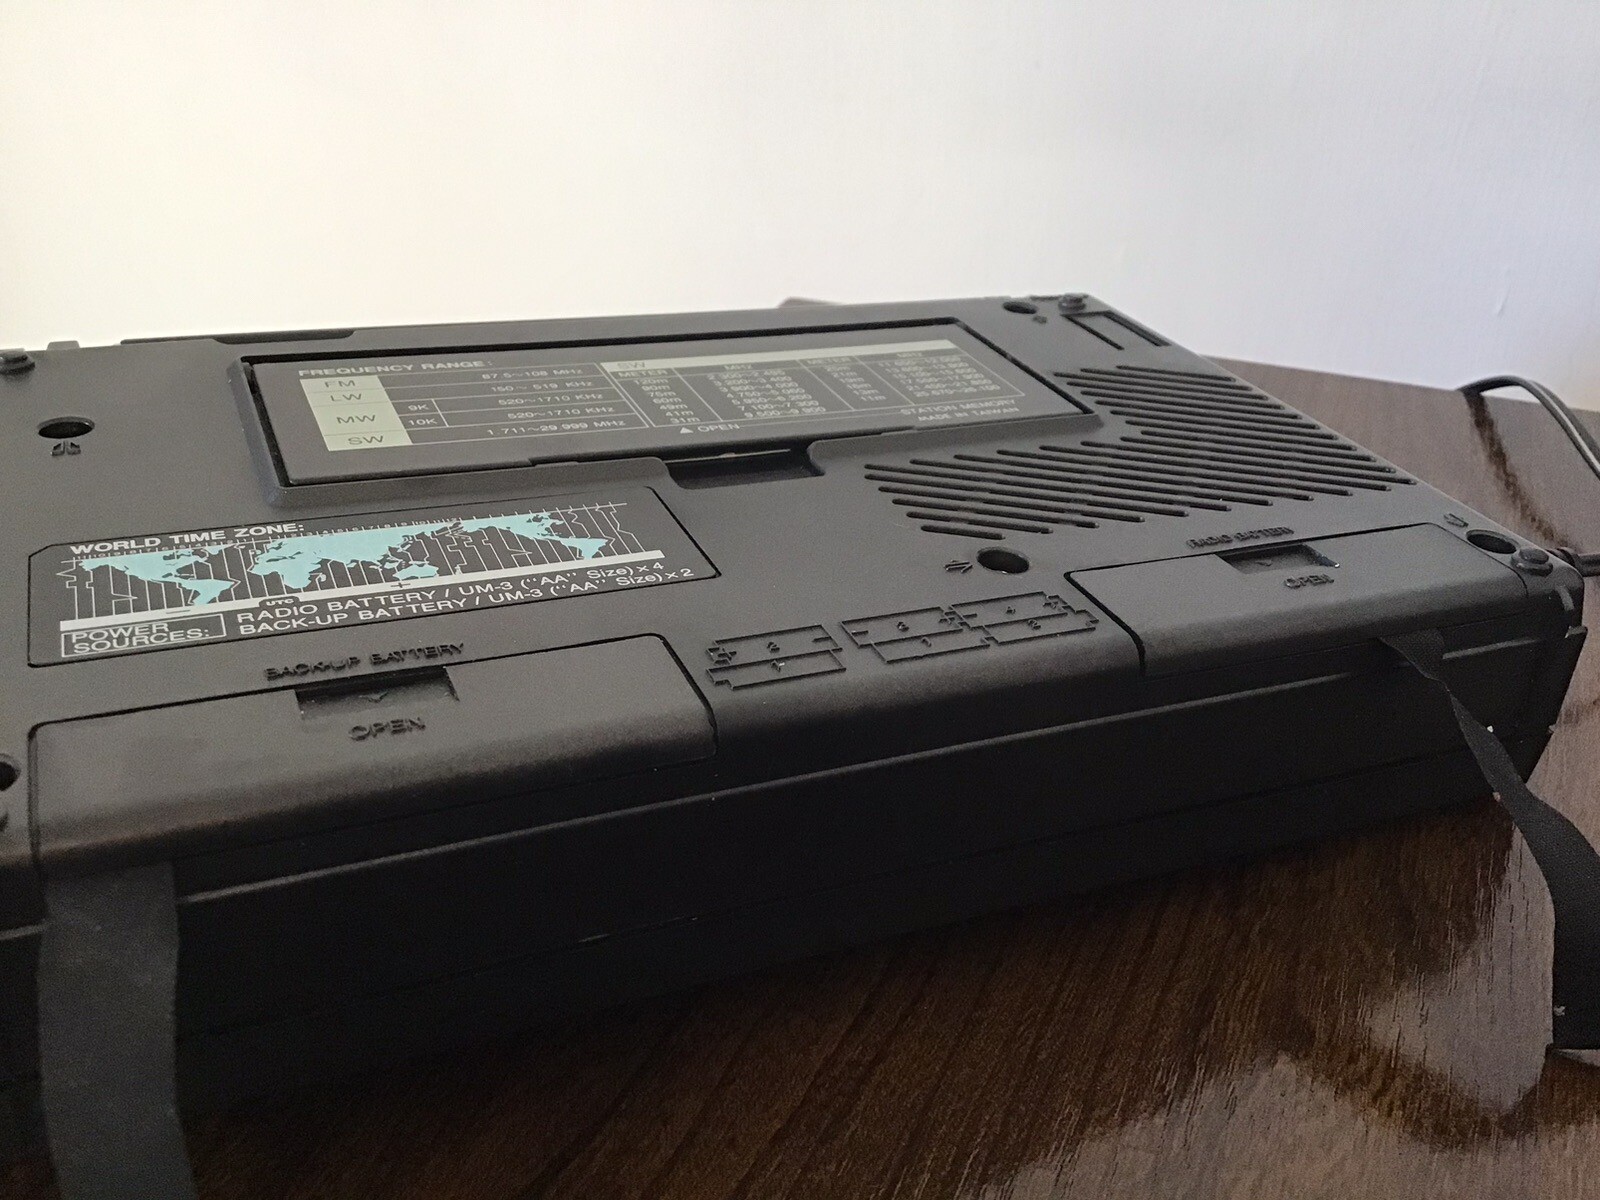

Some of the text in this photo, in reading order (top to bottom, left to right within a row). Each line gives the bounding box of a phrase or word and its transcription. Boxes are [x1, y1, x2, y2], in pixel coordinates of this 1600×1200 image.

[298, 364, 414, 377] FREQUENCY
[618, 370, 668, 378] METER
[325, 380, 356, 388] FM
[330, 393, 362, 402] LW
[336, 414, 376, 424] MW
[408, 418, 437, 426] 10K
[593, 420, 626, 428] MHz
[698, 423, 740, 432] OPEN
[348, 435, 384, 445] SW
[70, 523, 304, 554] WORLD TIME ZONE:
[1284, 574, 1335, 588] OPEN
[236, 604, 318, 624] RADIO
[327, 590, 435, 612] BATTERY
[458, 582, 514, 597] UM-3
[240, 613, 348, 636] BACK-UP
[357, 598, 466, 620] BATTERY
[488, 588, 543, 604] UM-3
[70, 622, 169, 644] POWER
[74, 629, 210, 654] SOURCES:
[265, 642, 464, 682] BACKUP BATTERY
[349, 717, 426, 742] OPEN
